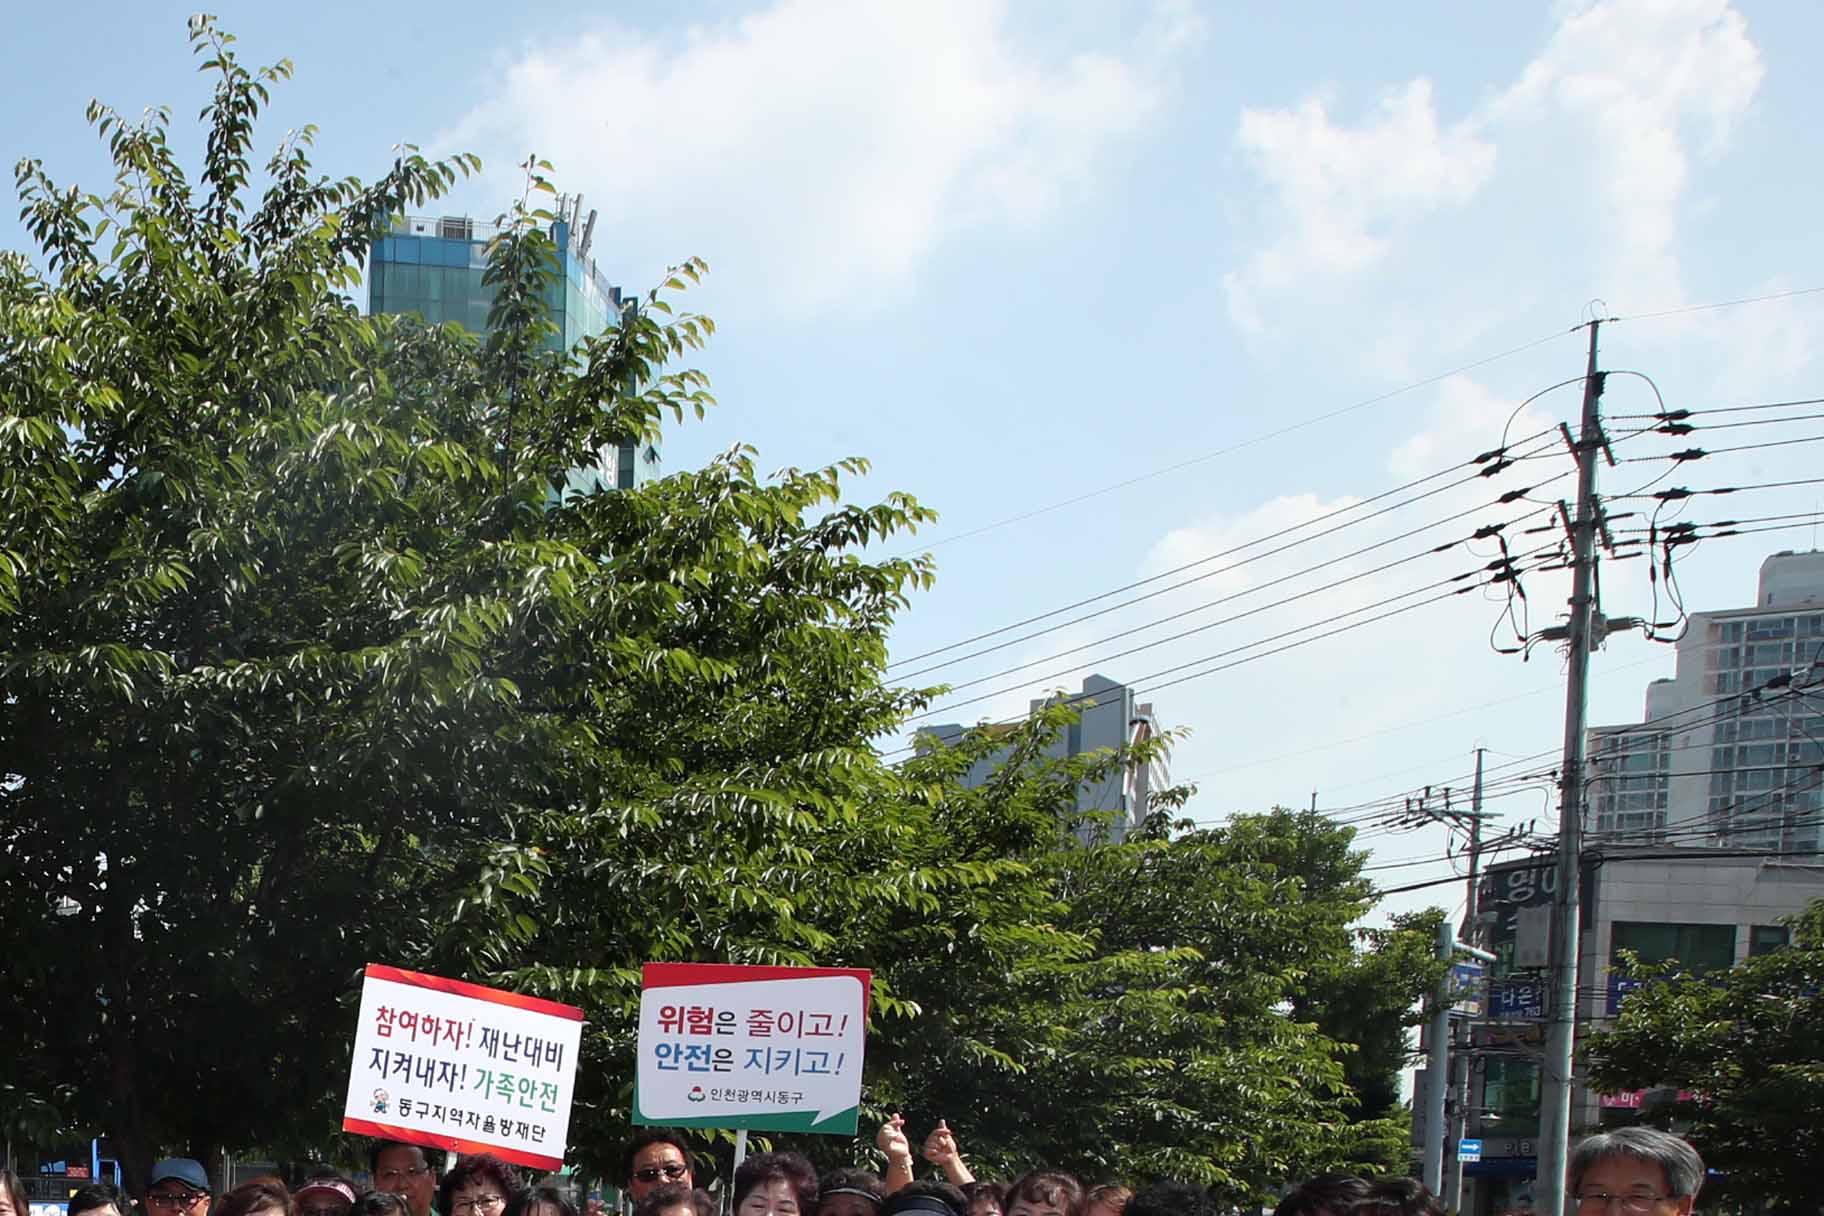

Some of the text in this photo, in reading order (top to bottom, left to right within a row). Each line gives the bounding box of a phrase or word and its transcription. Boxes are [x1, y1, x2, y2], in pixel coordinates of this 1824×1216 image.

[375, 1005, 564, 1072] 참여하자! 재난대비
[657, 1005, 849, 1039] 위험은 줄이고!
[369, 1047, 558, 1113] 지켜내자! 가족안전
[654, 1043, 845, 1076] 안전은 지키고!
[398, 1097, 546, 1143] 동구지역자율방재단
